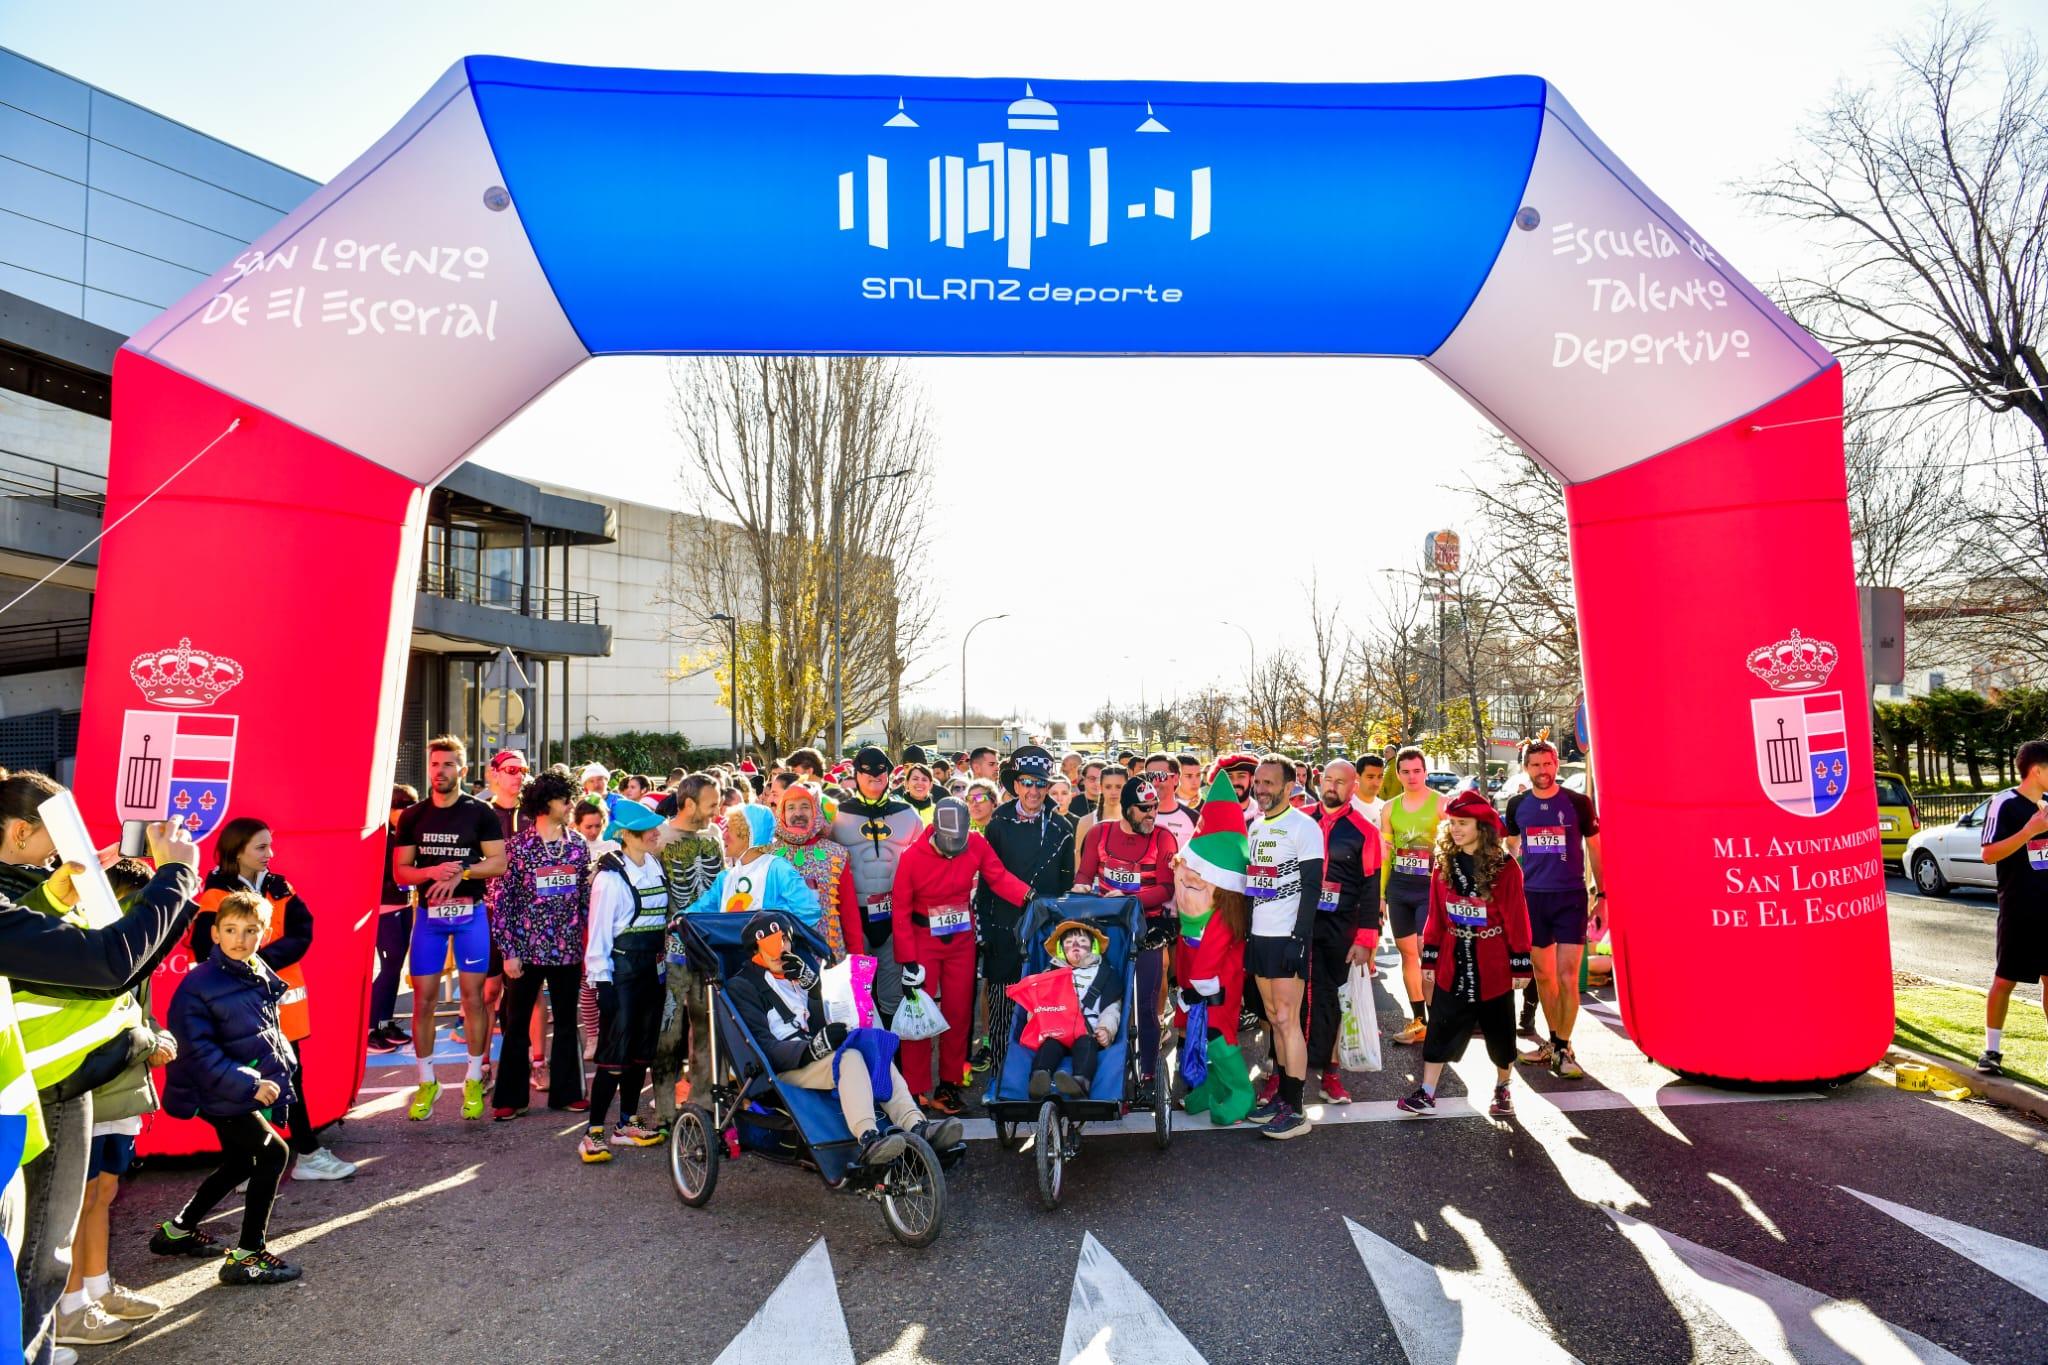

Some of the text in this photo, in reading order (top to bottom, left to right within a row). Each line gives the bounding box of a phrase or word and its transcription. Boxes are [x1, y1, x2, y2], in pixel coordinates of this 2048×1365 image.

[1552, 222, 1680, 265] Escuela
[1028, 282, 1183, 305] deporte
[1587, 272, 1728, 313] Talento
[322, 289, 498, 341] Escorial
[1552, 329, 1750, 375] Deportivo
[1533, 836, 1560, 846] 1375
[1712, 837, 1760, 858] M.I.
[1401, 857, 1423, 868] 1291
[544, 875, 572, 888] 1456
[1109, 870, 1135, 883] 1360
[1253, 877, 1273, 888] 1454
[435, 905, 467, 917] 1297
[1452, 903, 1480, 917] 1305
[937, 912, 964, 926] 1487
